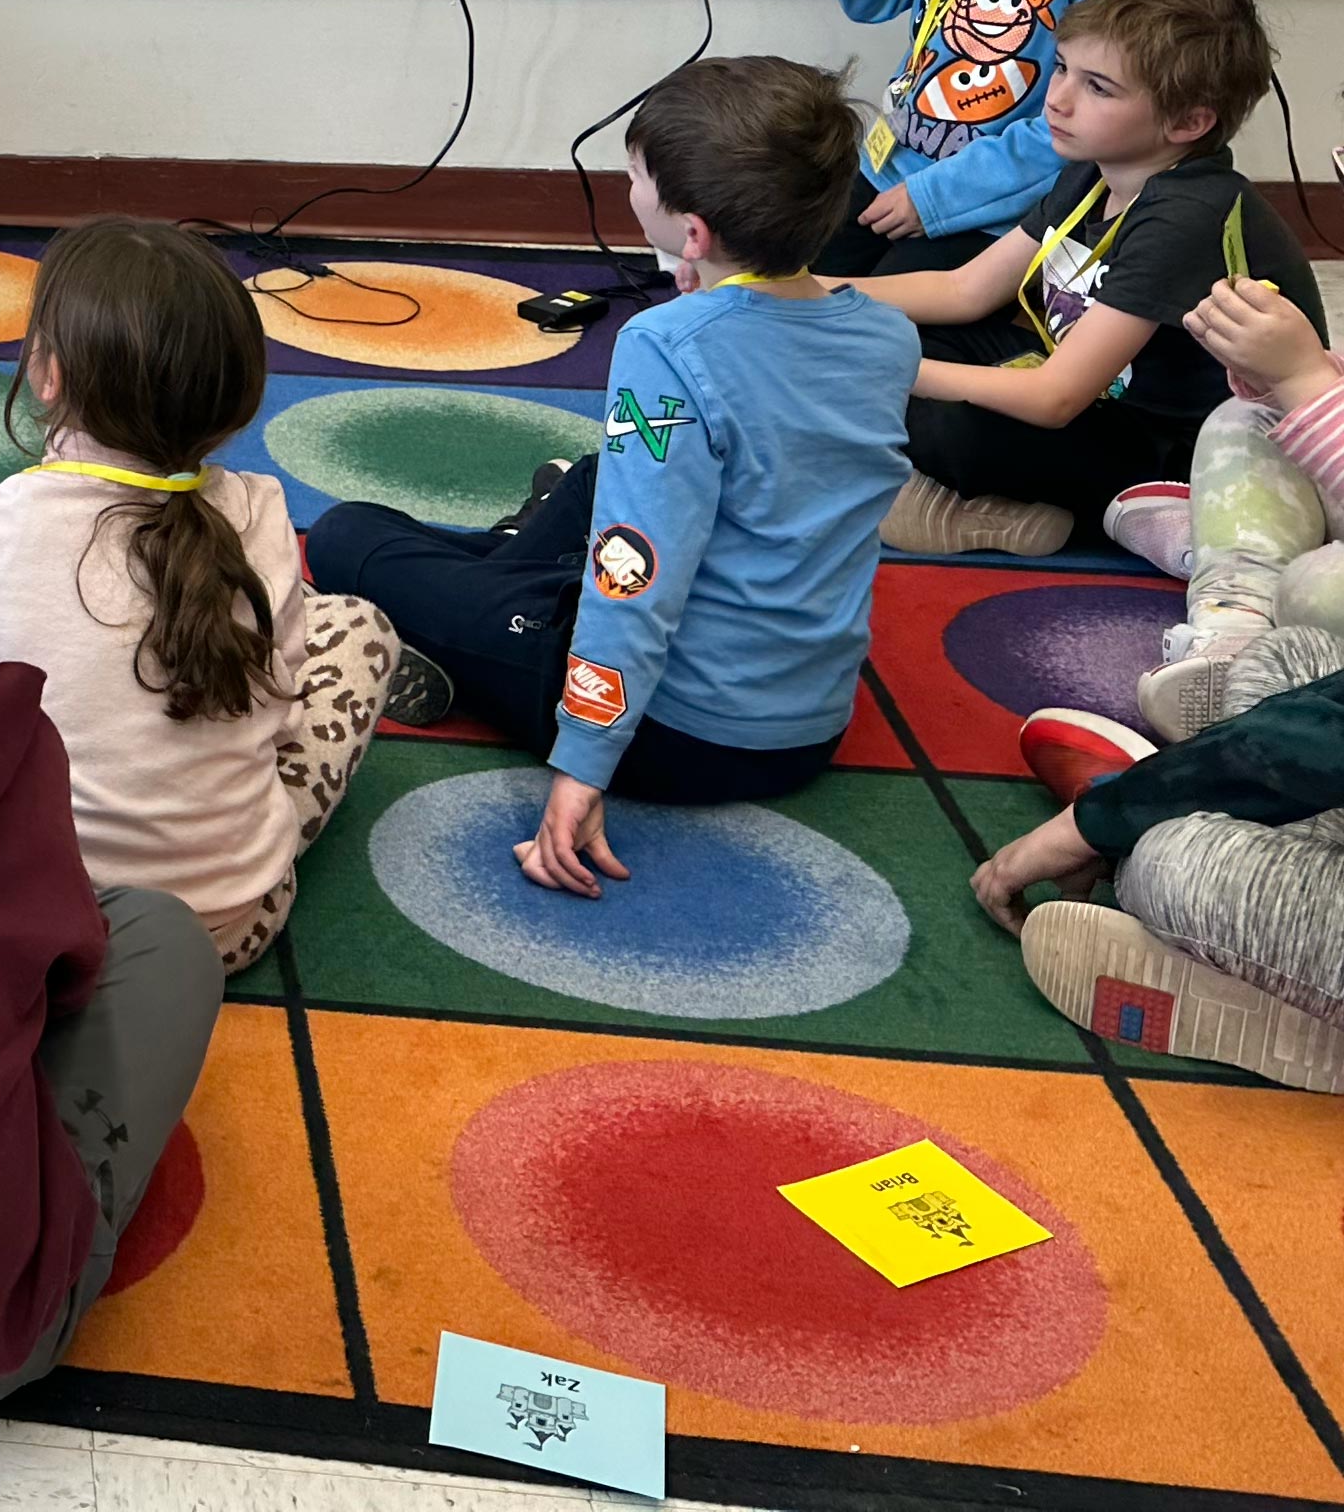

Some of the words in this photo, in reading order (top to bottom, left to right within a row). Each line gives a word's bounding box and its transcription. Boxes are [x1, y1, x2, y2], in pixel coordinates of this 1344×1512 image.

[572, 662, 615, 699] NIKE
[870, 1171, 919, 1193] Brian
[540, 1370, 581, 1393] Zak
